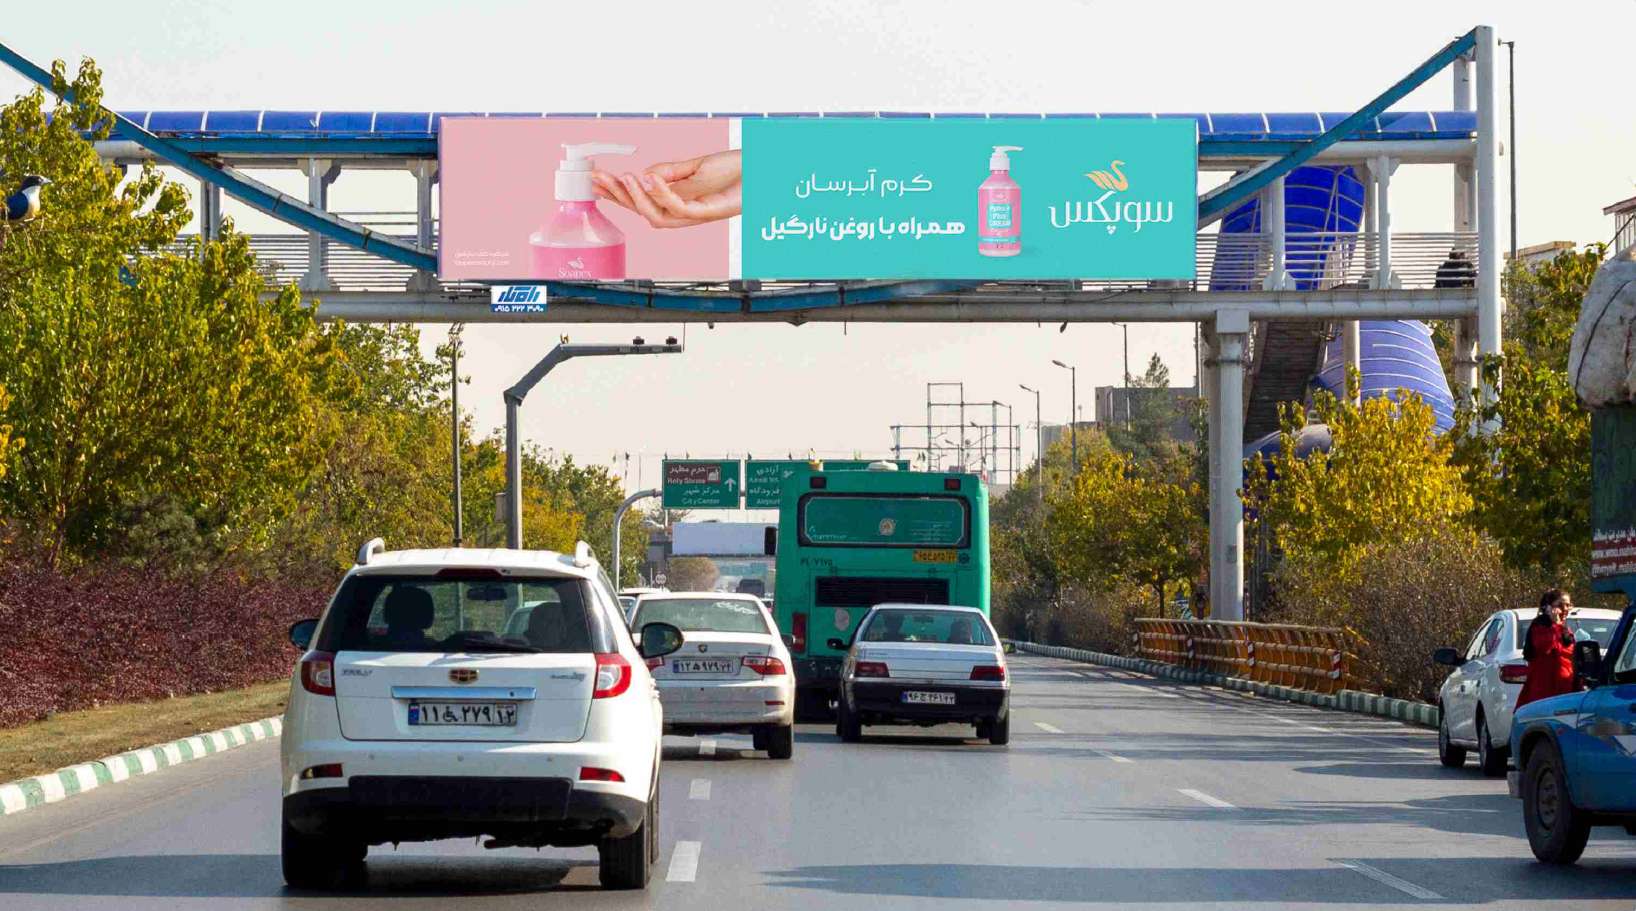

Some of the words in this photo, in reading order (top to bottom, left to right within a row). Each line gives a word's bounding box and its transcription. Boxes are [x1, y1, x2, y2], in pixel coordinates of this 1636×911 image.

[795, 169, 877, 198] آبرسان
[881, 174, 933, 197] کرم
[1048, 190, 1174, 235] سوپکس
[761, 214, 827, 241] نارگیل
[830, 216, 875, 241] روغن
[878, 216, 896, 240] با
[898, 217, 966, 240] همراه
[690, 466, 706, 477] حرم
[421, 704, 439, 723] ۱۱
[462, 704, 491, 723] ۲۷۹
